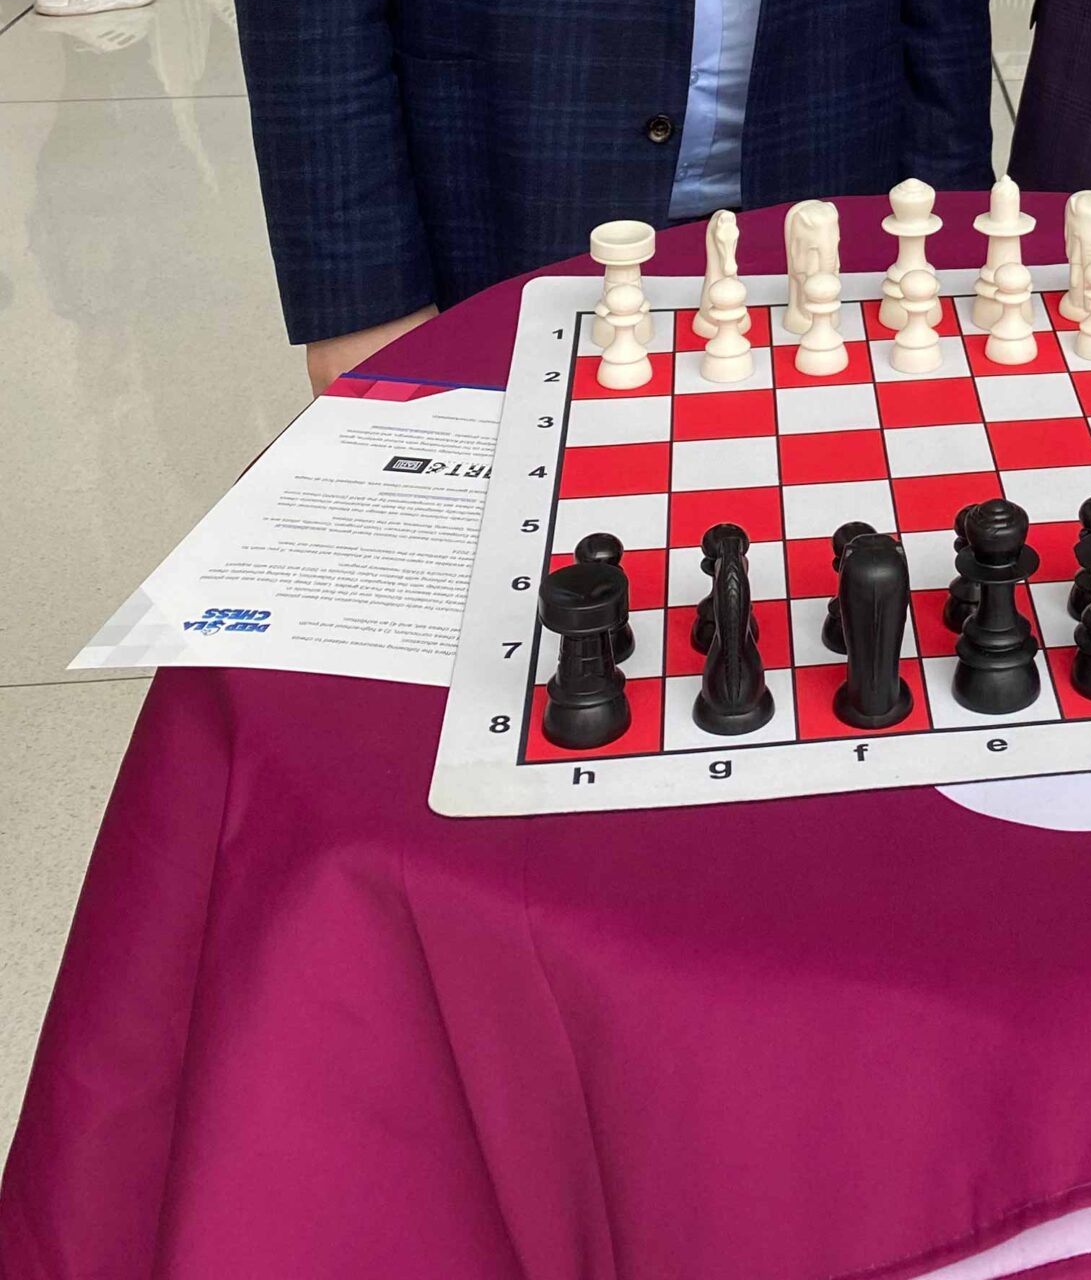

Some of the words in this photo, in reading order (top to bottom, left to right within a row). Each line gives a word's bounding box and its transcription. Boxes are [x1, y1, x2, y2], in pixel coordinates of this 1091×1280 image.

[552, 329, 564, 340] 1
[544, 371, 562, 384] 2
[537, 416, 554, 430] 3
[528, 464, 549, 478] 4
[520, 519, 540, 533] 5
[511, 575, 531, 591] 6
[202, 608, 271, 621] CHESS
[224, 622, 271, 632] DEEP
[502, 641, 523, 659] 7
[489, 715, 511, 734] 8
[571, 766, 596, 785] h
[709, 760, 732, 780] g
[854, 743, 870, 763] f
[986, 738, 1008, 752] e
